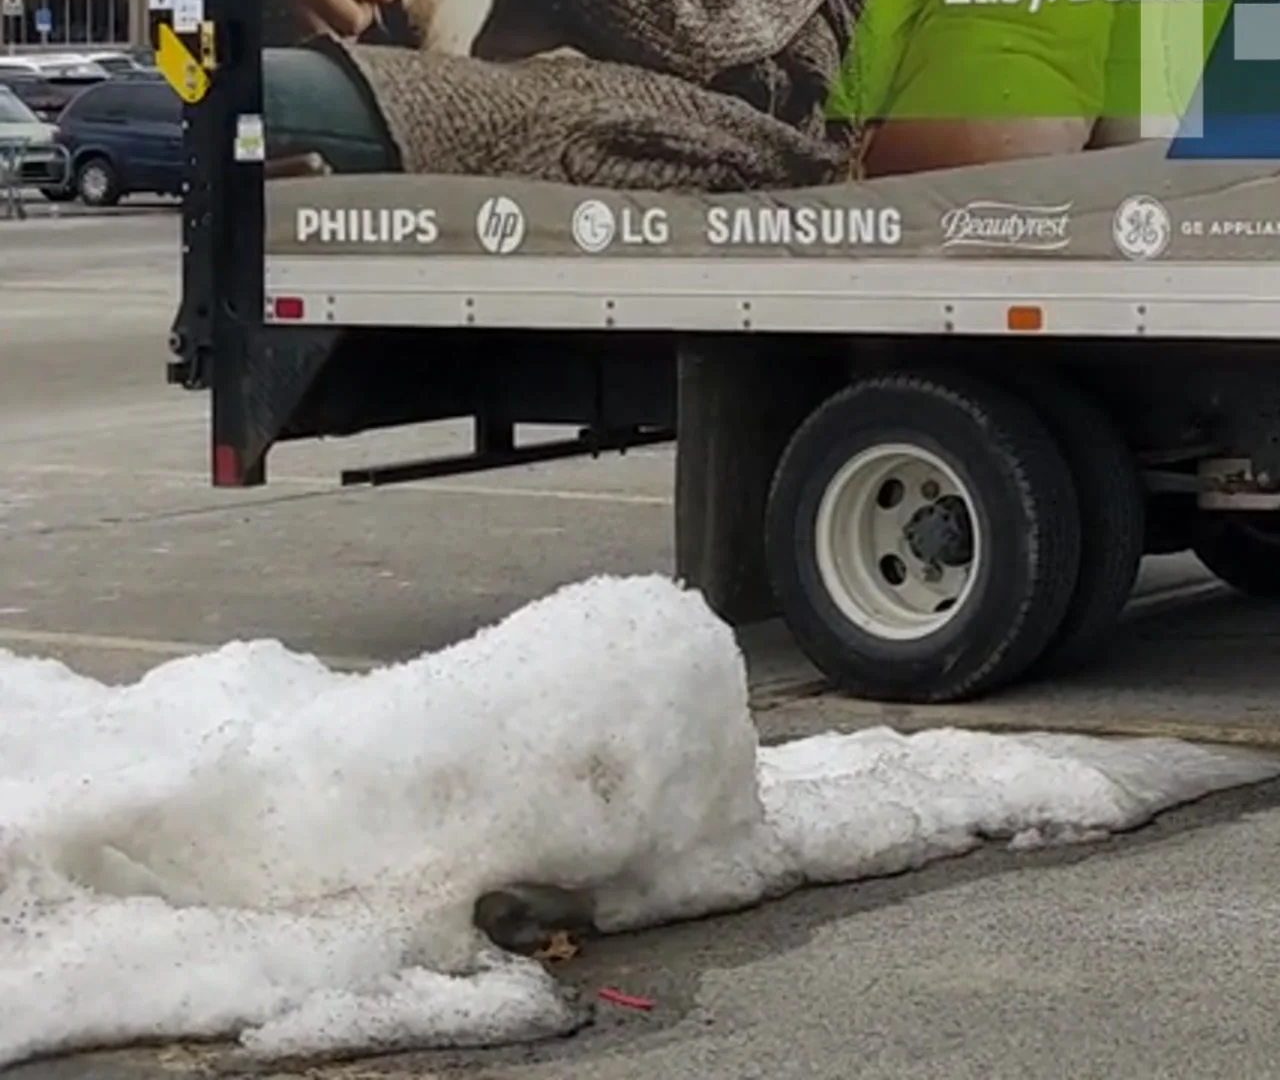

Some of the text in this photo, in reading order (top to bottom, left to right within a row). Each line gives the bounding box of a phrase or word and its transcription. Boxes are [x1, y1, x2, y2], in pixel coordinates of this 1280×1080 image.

[296, 207, 439, 244] PHILIPS
[476, 196, 526, 254] hp
[622, 208, 669, 244] LG
[707, 207, 901, 245] SAMSUNG
[940, 208, 1069, 245] Beautyrest
[1180, 220, 1204, 236] GE
